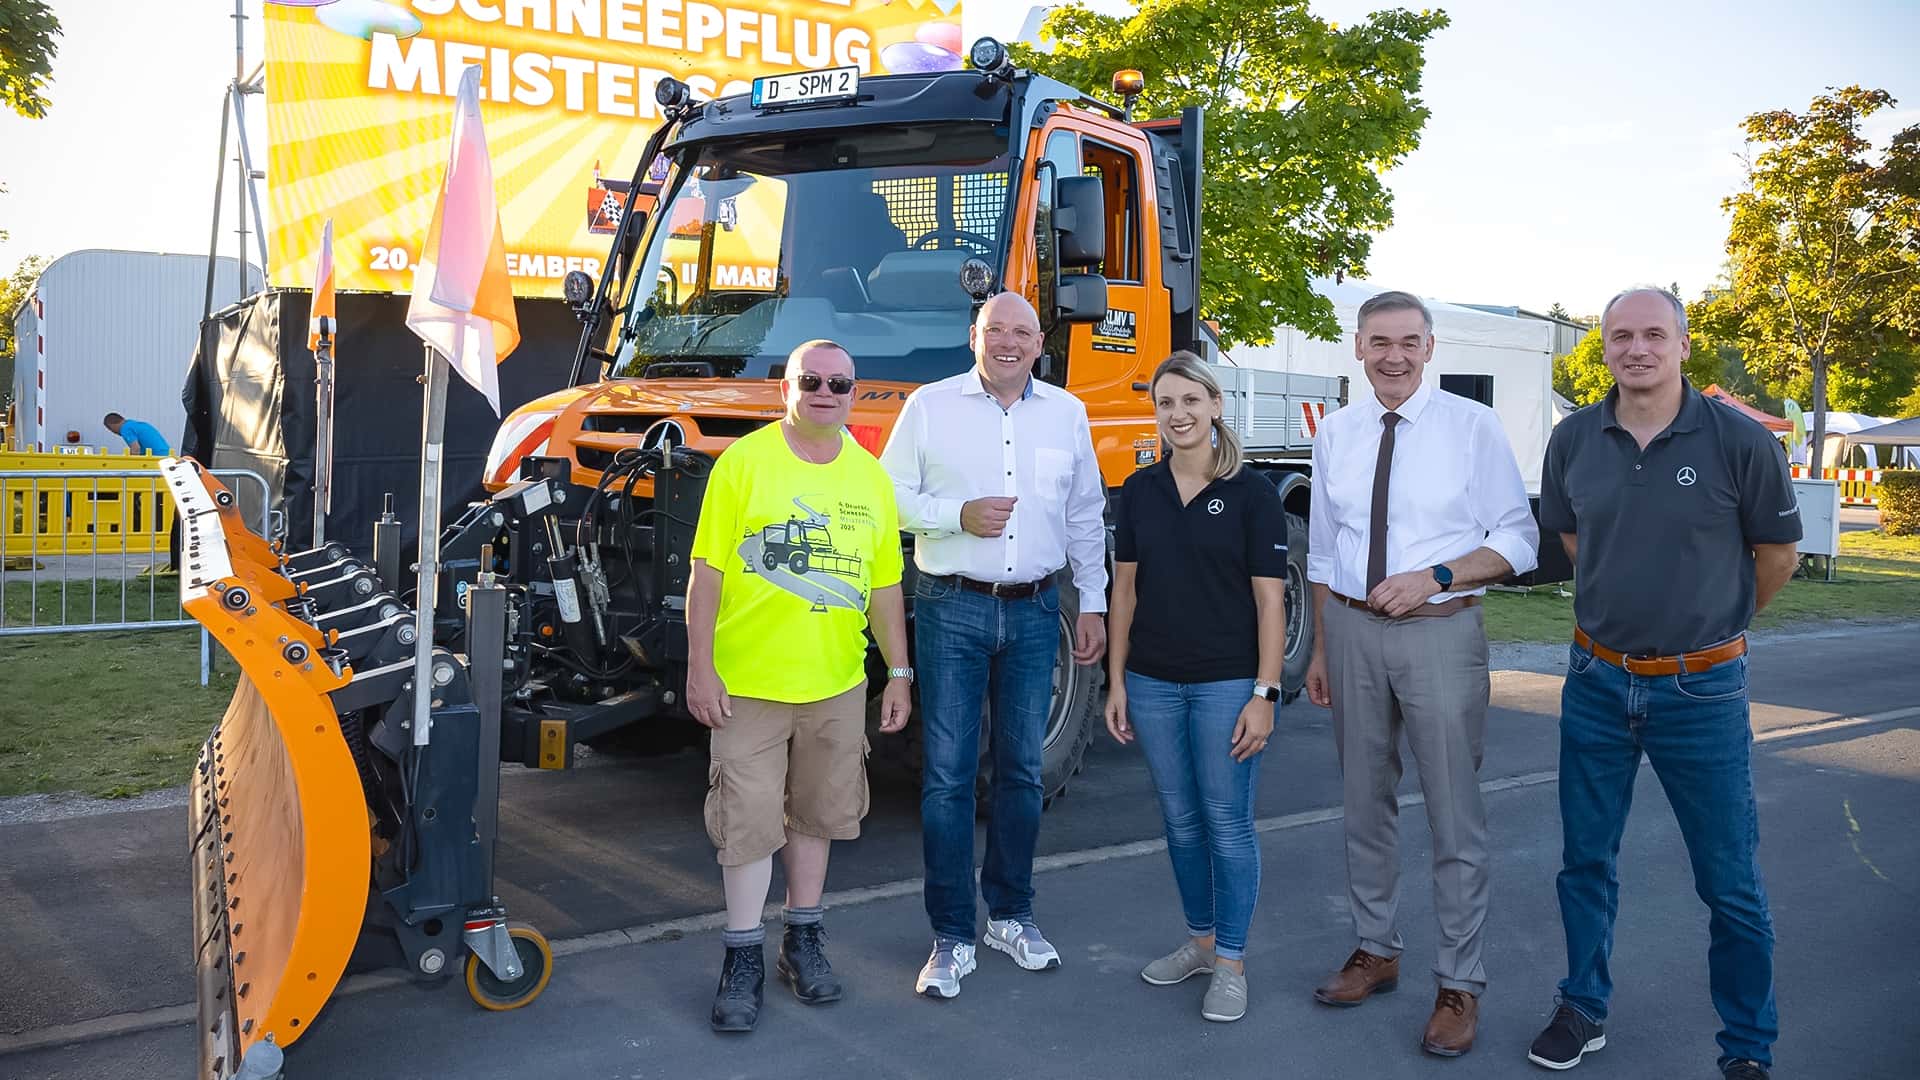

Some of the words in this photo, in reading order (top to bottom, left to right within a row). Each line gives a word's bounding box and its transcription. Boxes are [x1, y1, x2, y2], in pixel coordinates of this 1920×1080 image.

[768, 81, 779, 99] D
[798, 74, 832, 96] SPM
[839, 72, 849, 91] 2
